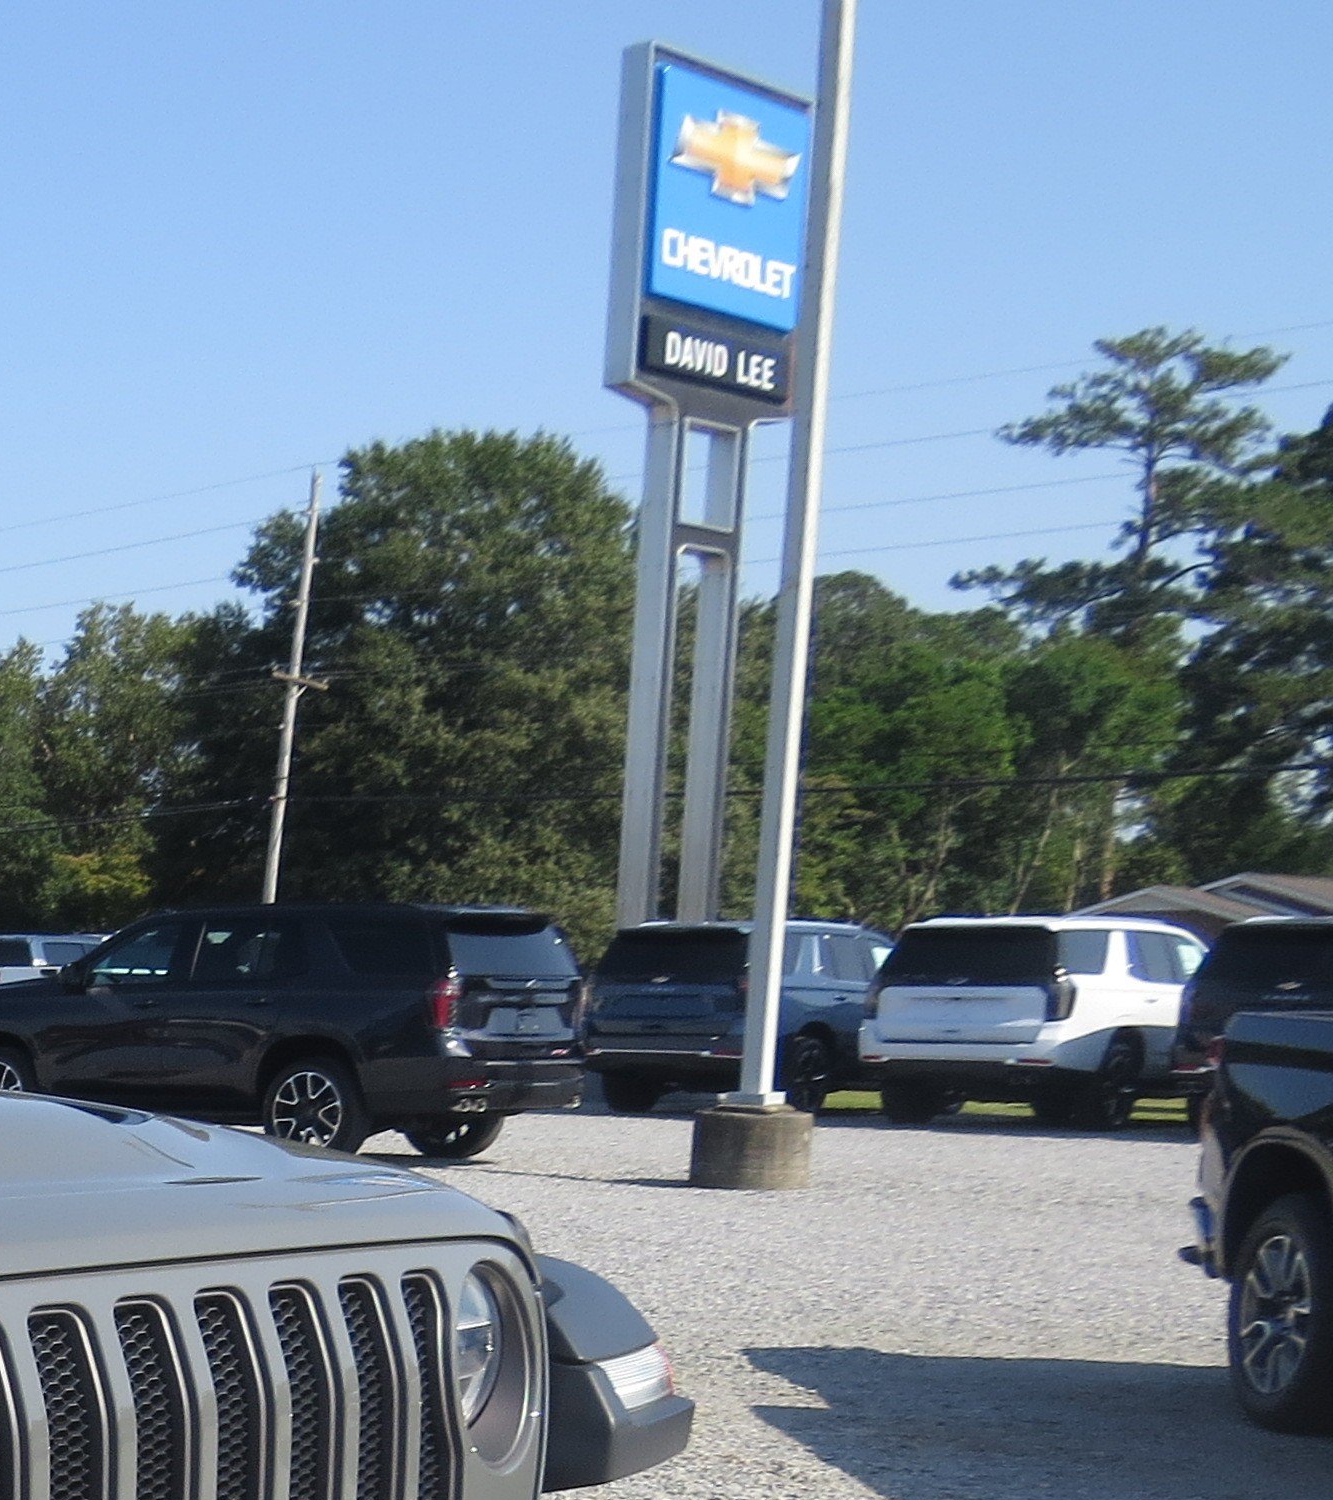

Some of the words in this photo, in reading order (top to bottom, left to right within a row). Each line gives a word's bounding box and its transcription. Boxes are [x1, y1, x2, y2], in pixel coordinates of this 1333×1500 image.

[661, 227, 796, 298] CHEVROLET
[664, 331, 729, 378] DAVID
[736, 349, 776, 391] LEE
